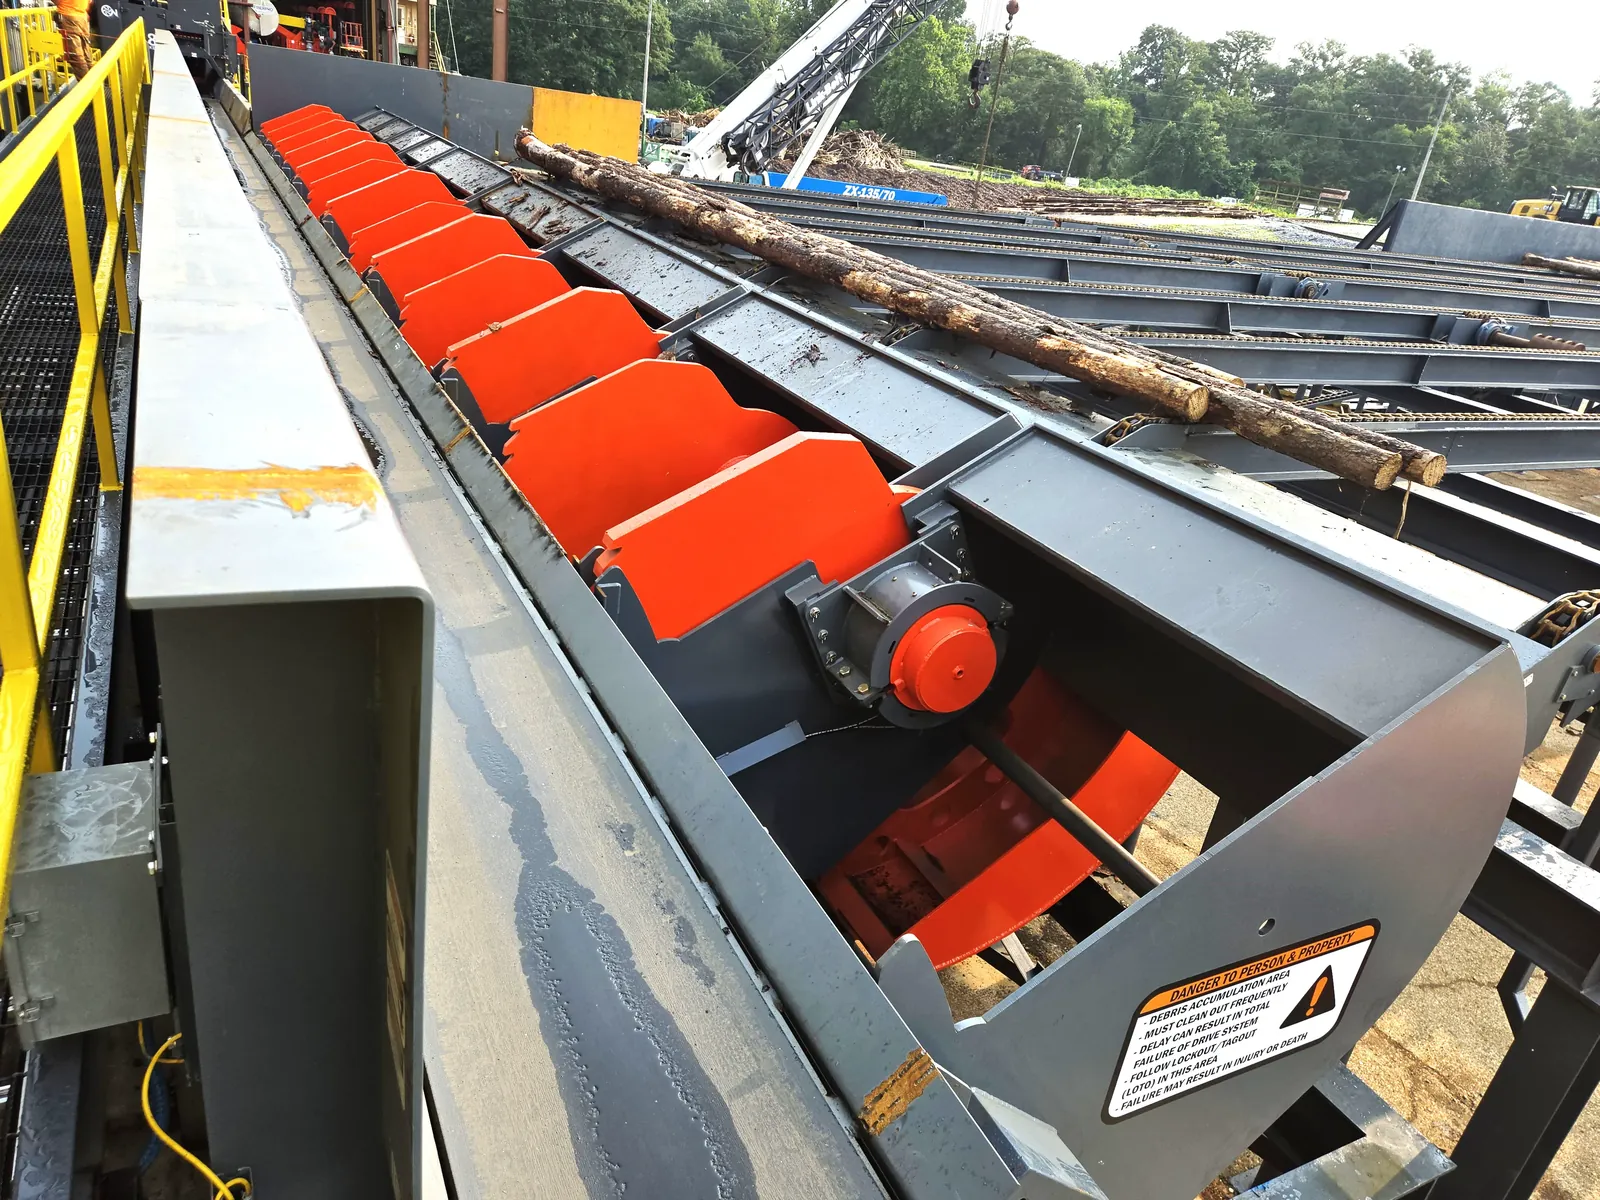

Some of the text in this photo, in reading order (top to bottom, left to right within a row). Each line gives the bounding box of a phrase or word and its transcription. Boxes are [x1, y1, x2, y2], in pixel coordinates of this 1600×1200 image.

[842, 184, 896, 201] ZX-135/70
[1170, 932, 1355, 1002] DANGER TO PERSON & PROPERTY
[1144, 1022, 1175, 1040] MUST
[1176, 1011, 1208, 1028] CLEAN
[1209, 1003, 1230, 1016] OUT
[1230, 982, 1288, 1010] FREQUENTLY
[1149, 1004, 1188, 1025] DEBRIS
[1188, 978, 1265, 1011] ACCUMULATION
[1266, 970, 1290, 984] AREA
[1133, 1016, 1259, 1069] FAILURE OF DRIVE SYSTEM
[1139, 1036, 1172, 1054] DELAY
[1173, 1028, 1194, 1042] CAN
[1195, 1014, 1231, 1034] RESULT
[1232, 1010, 1242, 1020] IN
[1244, 1001, 1270, 1016] TOTAL
[1121, 1088, 1163, 1110] FAILURE
[1163, 1079, 1186, 1093] MAY
[1186, 1065, 1222, 1085] RESULT
[1222, 1060, 1233, 1071] IN
[1233, 1048, 1266, 1066] INJURY
[1266, 1043, 1280, 1054] OR
[1280, 1032, 1308, 1049] DEATH
[1122, 1055, 1218, 1100] (LOTO) IN THIS AREA
[1130, 1061, 1171, 1083] FOLLOW
[1172, 1029, 1257, 1067] LOCKOUT/TAGOUT
